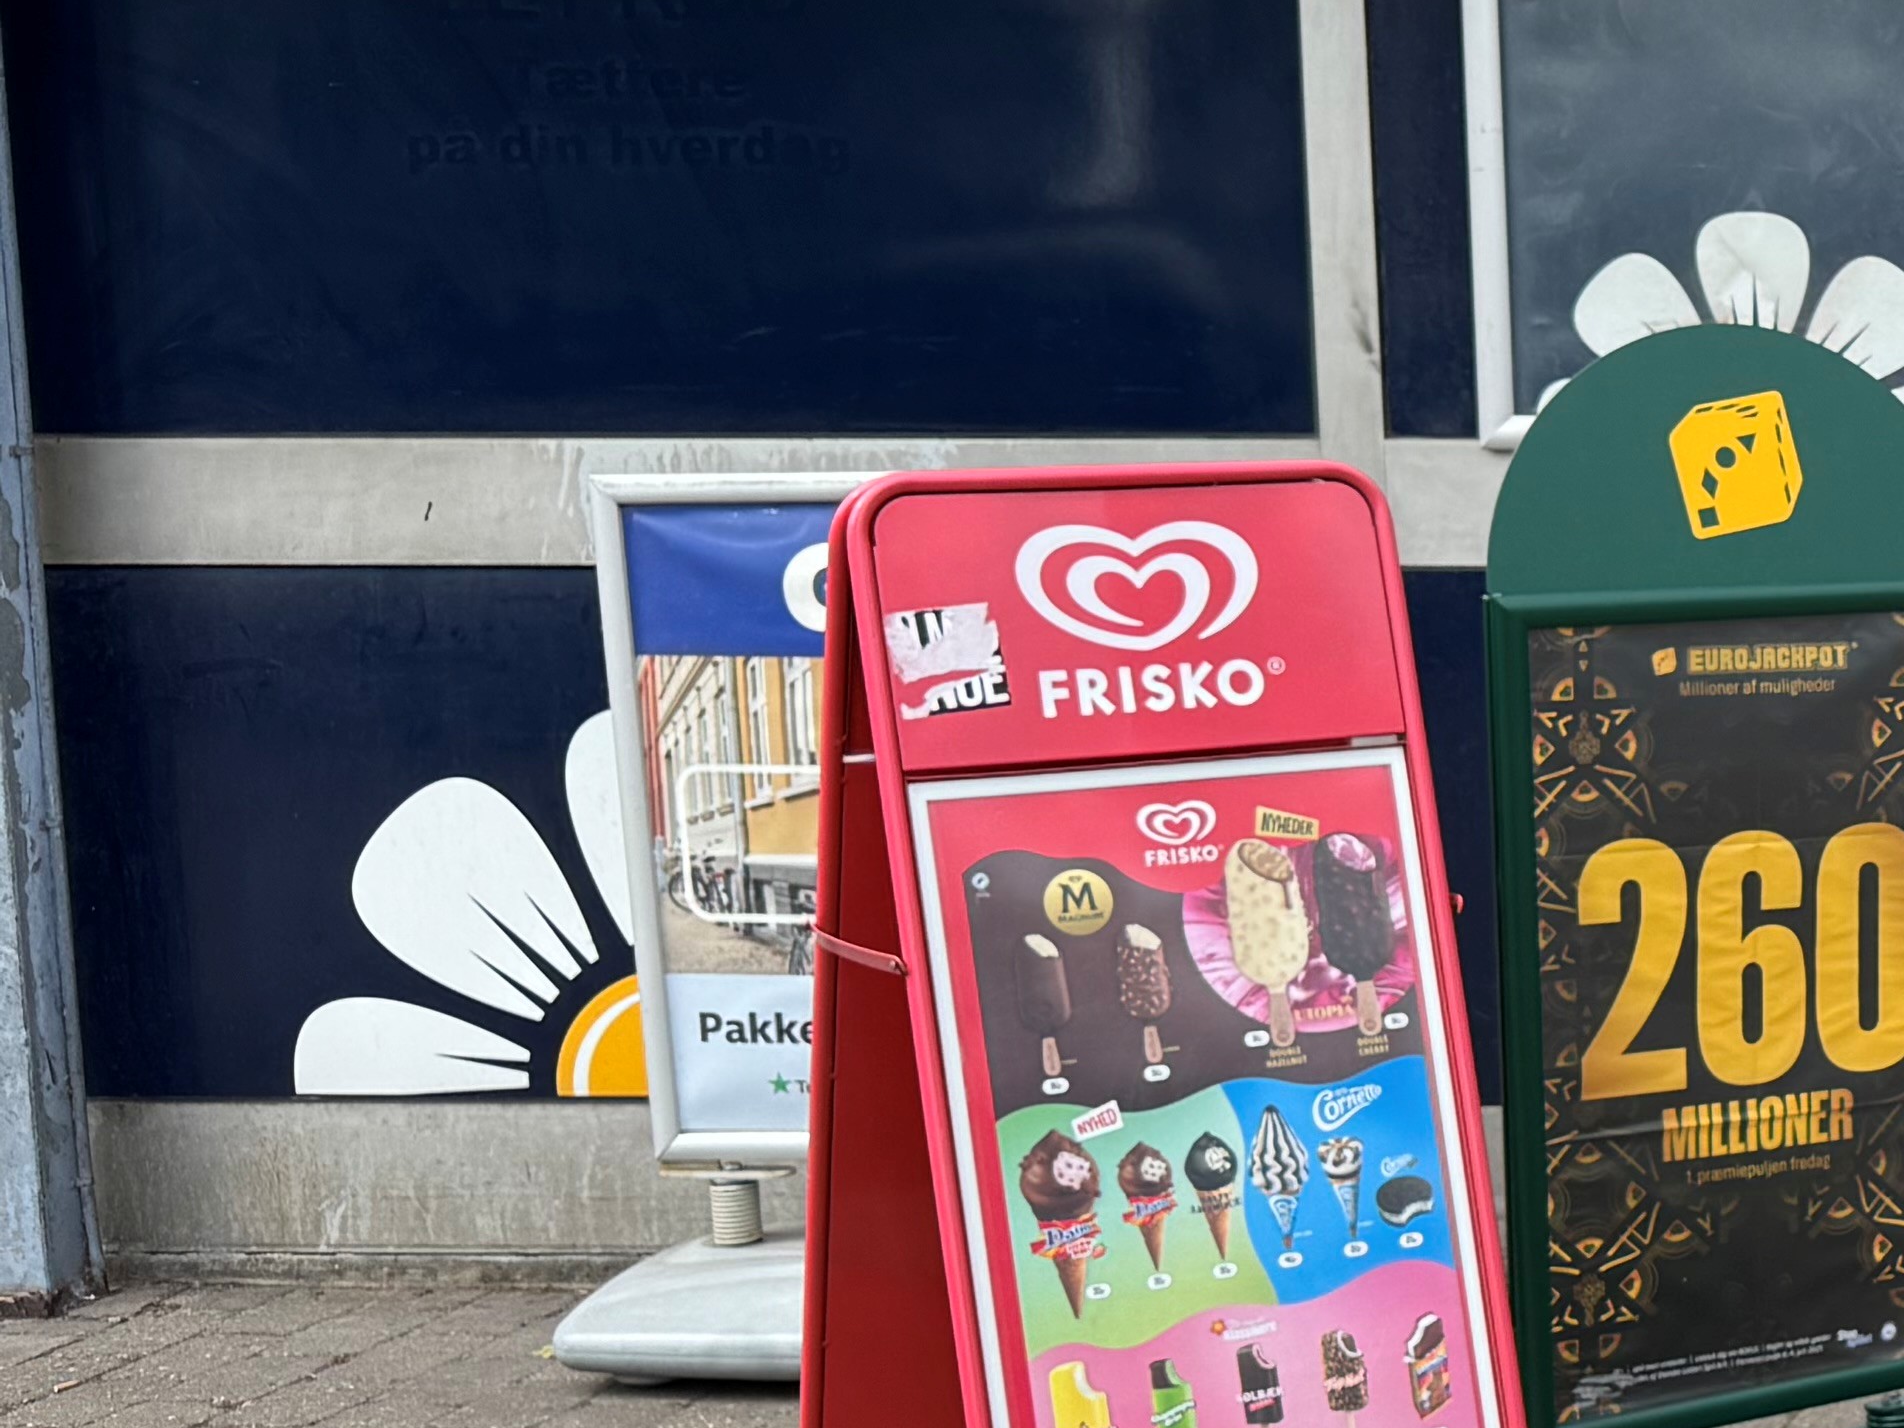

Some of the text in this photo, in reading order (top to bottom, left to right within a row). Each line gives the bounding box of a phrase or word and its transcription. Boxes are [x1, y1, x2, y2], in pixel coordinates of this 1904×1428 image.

[1688, 642, 1849, 675] EUROJACKPOT
[1038, 658, 1265, 719] FRISKO
[1145, 844, 1218, 867] FRISKO
[1662, 1088, 1855, 1162] MILLIONER
